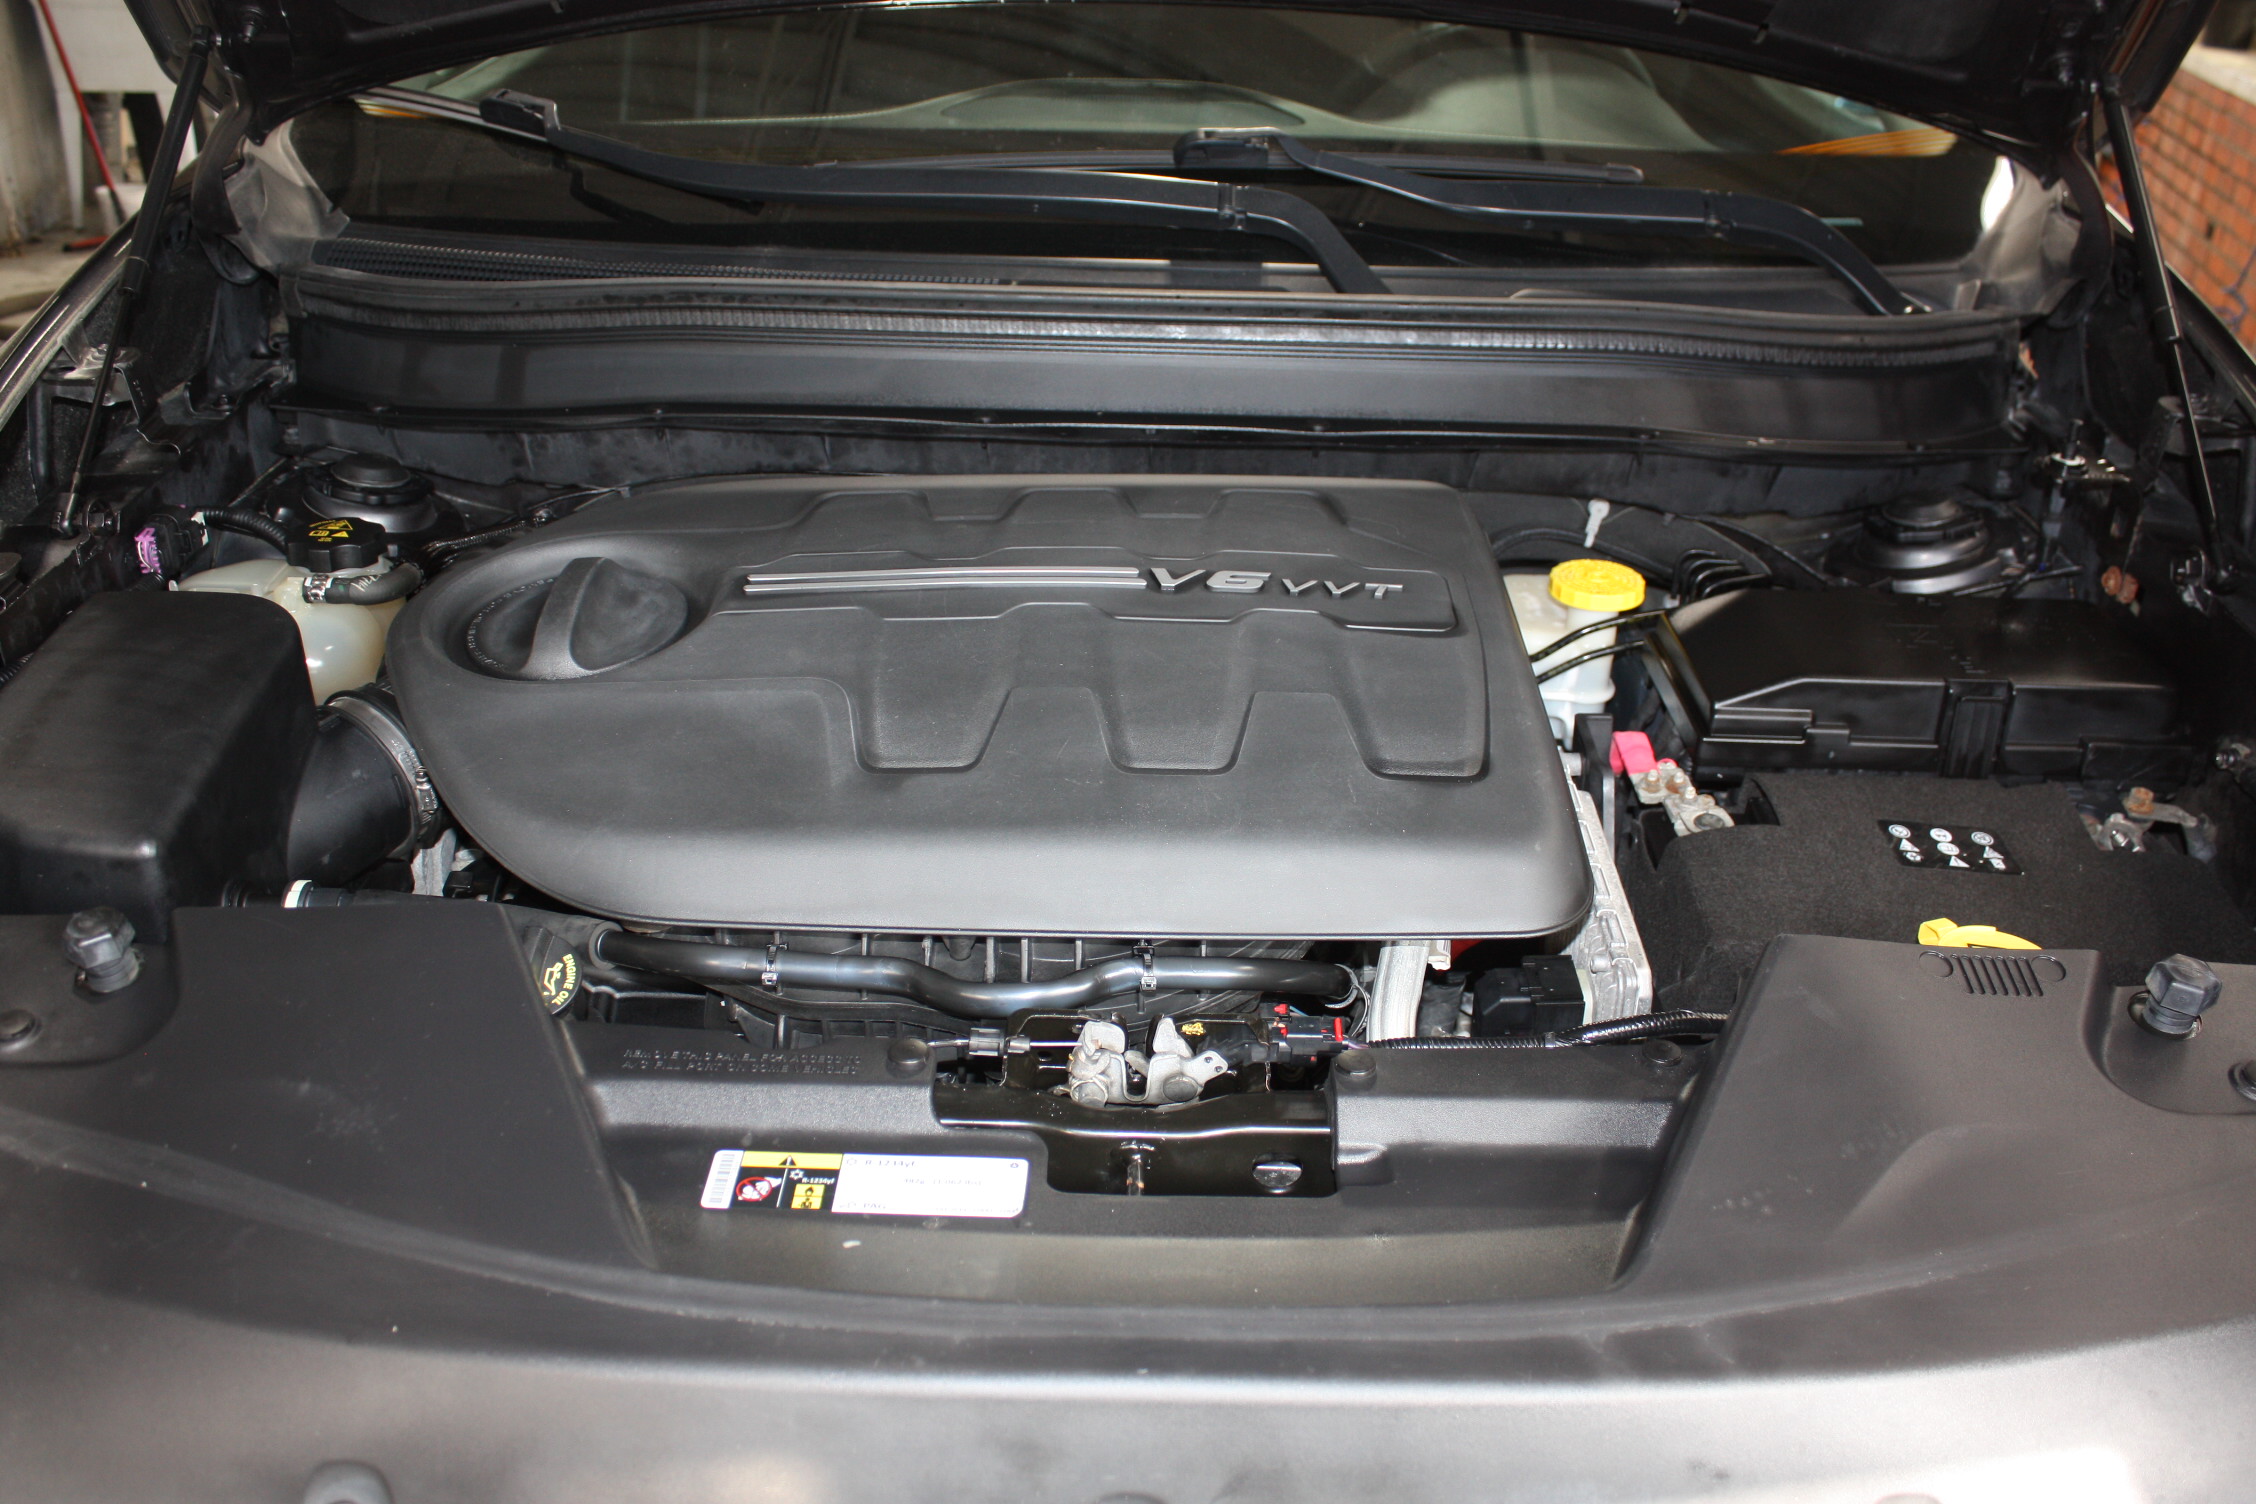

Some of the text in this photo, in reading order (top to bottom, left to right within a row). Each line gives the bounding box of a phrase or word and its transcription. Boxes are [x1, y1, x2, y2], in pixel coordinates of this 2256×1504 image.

[1151, 567, 1403, 599] V6 VVT
[551, 953, 577, 1005] ENGINE OIL
[714, 1052, 756, 1062] PANEL
[760, 1053, 787, 1063] FOR
[751, 1064, 789, 1073] SOME
